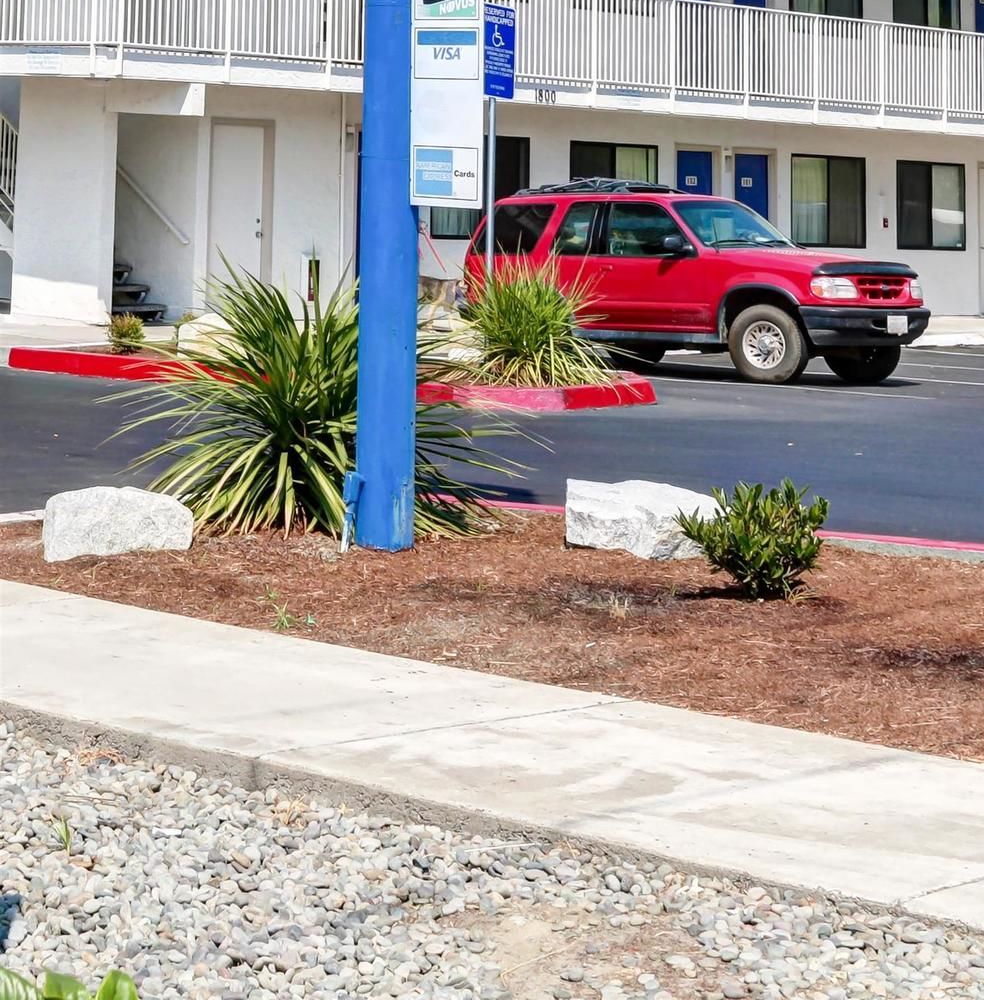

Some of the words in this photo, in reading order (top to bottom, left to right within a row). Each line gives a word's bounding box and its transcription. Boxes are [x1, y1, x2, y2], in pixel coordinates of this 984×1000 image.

[433, 46, 461, 60] VISA
[535, 88, 556, 104] 1800
[454, 170, 475, 178] Cards
